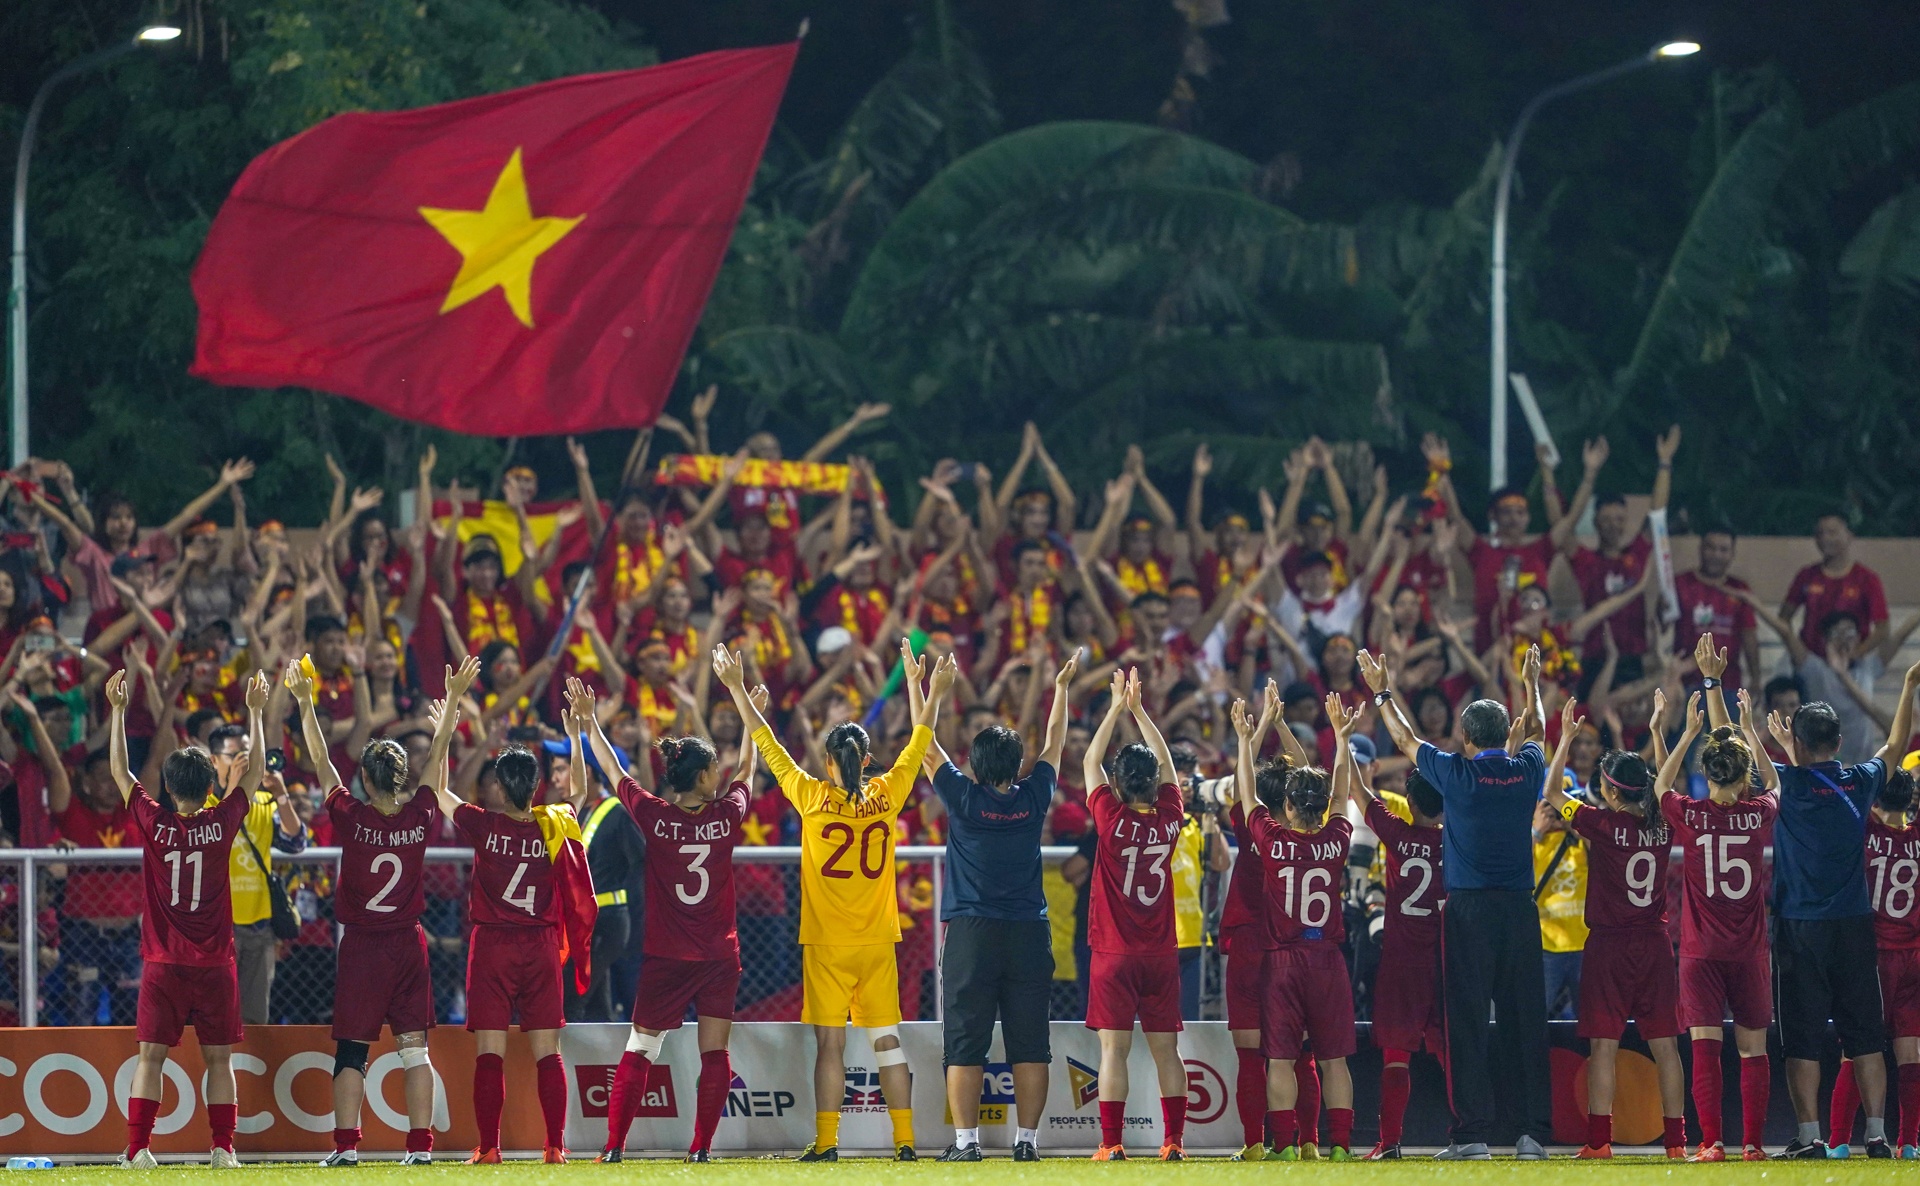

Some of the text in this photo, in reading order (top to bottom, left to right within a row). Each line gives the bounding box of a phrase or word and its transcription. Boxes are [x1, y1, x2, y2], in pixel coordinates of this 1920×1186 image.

[1478, 775, 1524, 785] VIETNAM
[154, 822, 223, 847] T.T. THAO
[354, 823, 384, 846] T.T.H.
[654, 818, 731, 841] C.T. KIEU
[981, 811, 1029, 820] VIETNAM
[1614, 827, 1629, 847] H.
[485, 832, 513, 856] H.T.
[820, 820, 890, 880] 20
[1311, 840, 1342, 861] VAN
[1695, 834, 1752, 900] 15
[164, 850, 203, 912] 11
[365, 852, 403, 913] 2
[501, 862, 536, 916] 4
[675, 844, 711, 905] 3
[1120, 844, 1171, 906] 13
[1278, 866, 1332, 928] 16
[1400, 858, 1446, 917] 2
[1625, 850, 1657, 908] 9
[1869, 856, 1919, 919] 18
[1186, 1071, 1212, 1113] 5
[1049, 1116, 1096, 1125] PEOPLE'S
